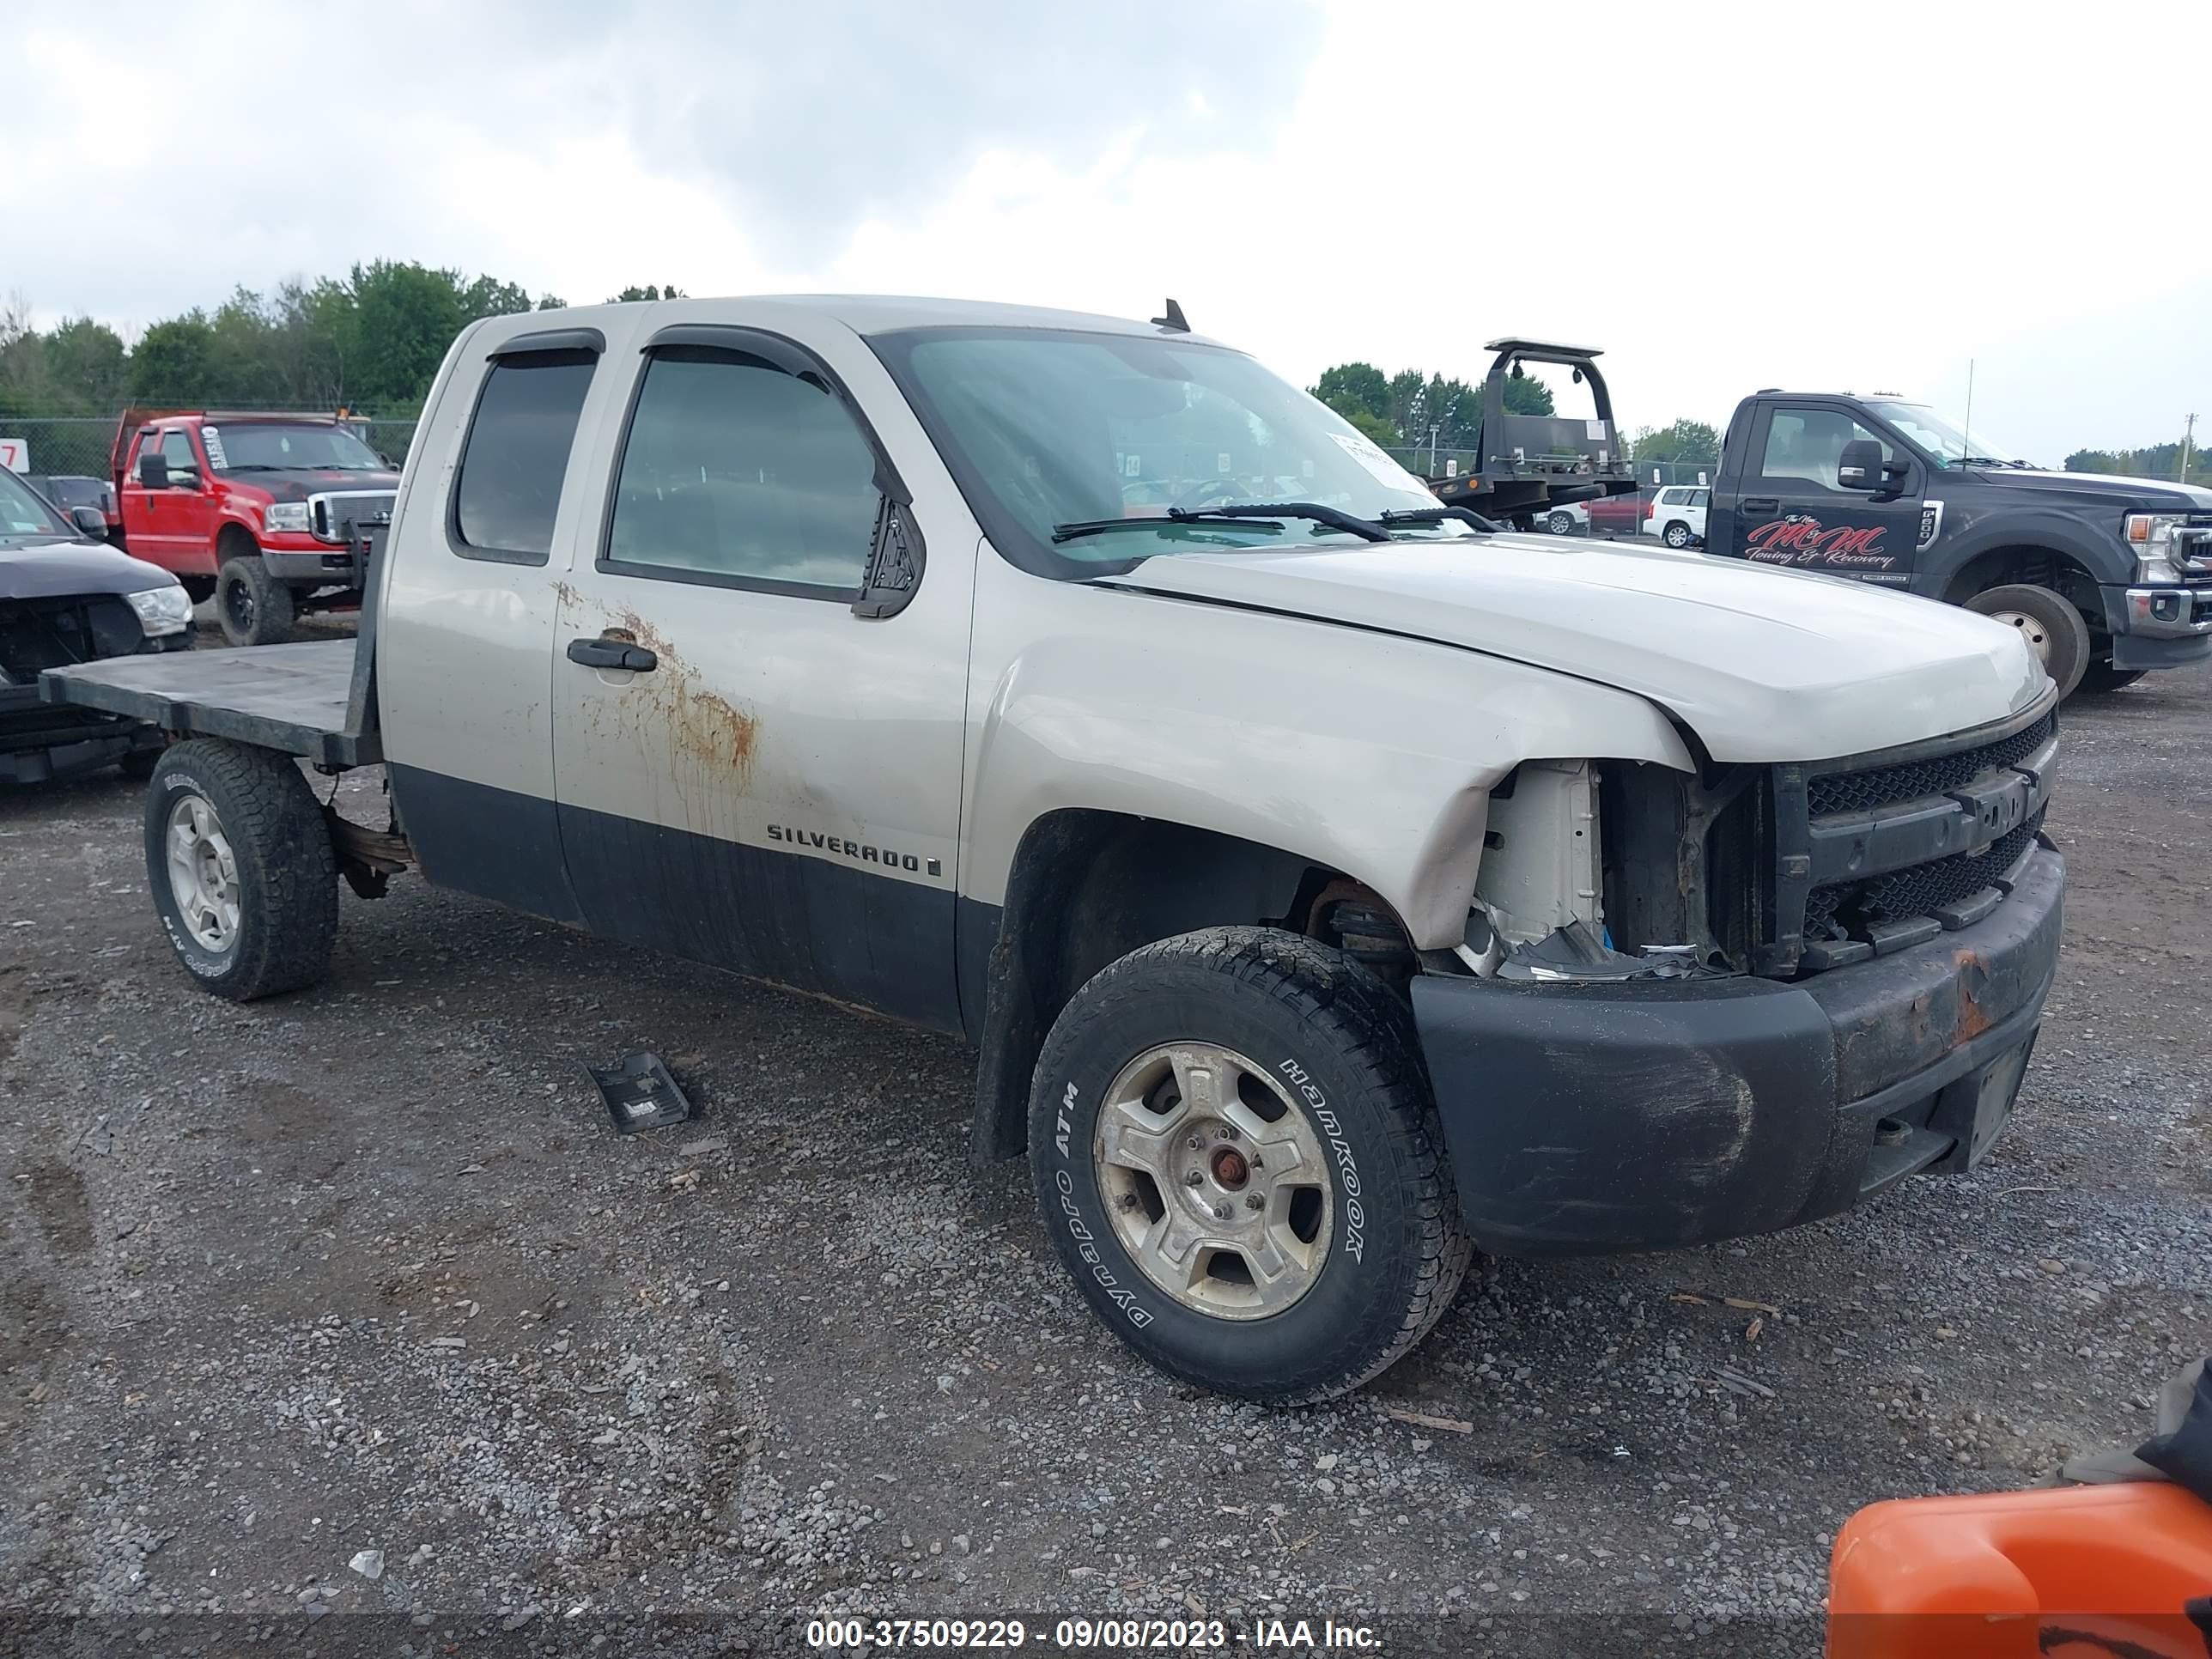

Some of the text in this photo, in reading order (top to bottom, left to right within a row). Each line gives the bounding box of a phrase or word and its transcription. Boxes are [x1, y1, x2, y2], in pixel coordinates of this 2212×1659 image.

[1744, 547, 1897, 570] Towing & Recovery
[767, 823, 919, 872] SILVERADO
